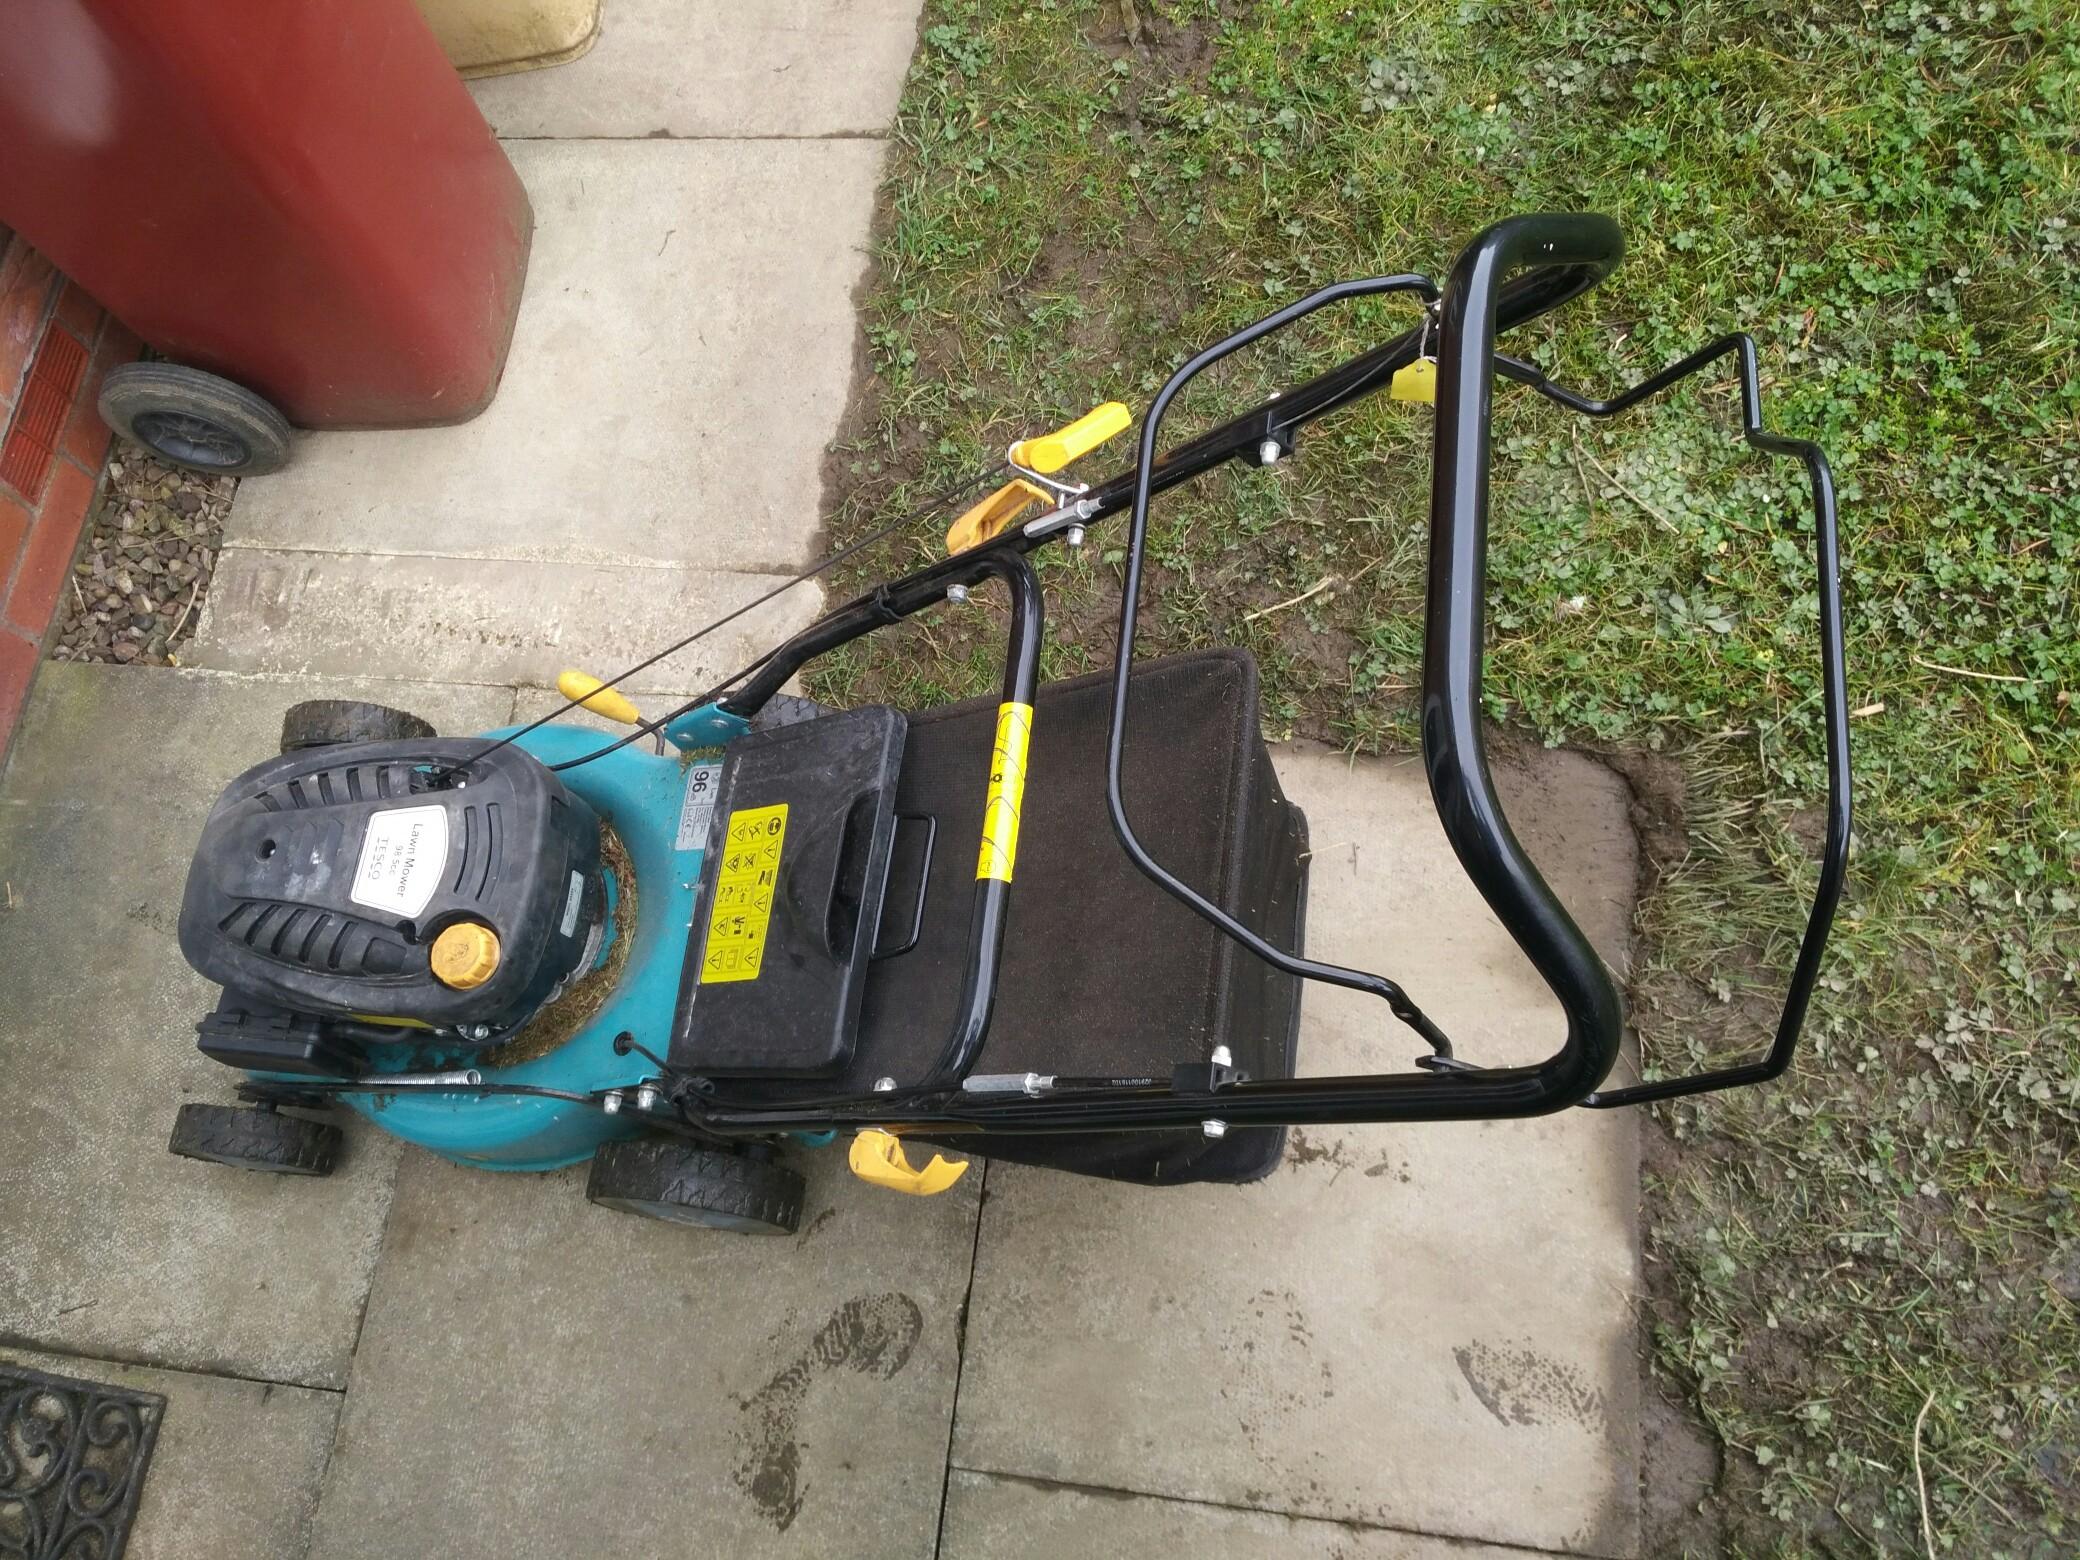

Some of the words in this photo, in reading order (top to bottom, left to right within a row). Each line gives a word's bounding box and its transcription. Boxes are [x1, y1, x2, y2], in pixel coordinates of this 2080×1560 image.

[692, 771, 709, 793] 96
[407, 823, 424, 854] Lawn
[371, 838, 390, 880] TESCO
[397, 858, 415, 897] Mower
